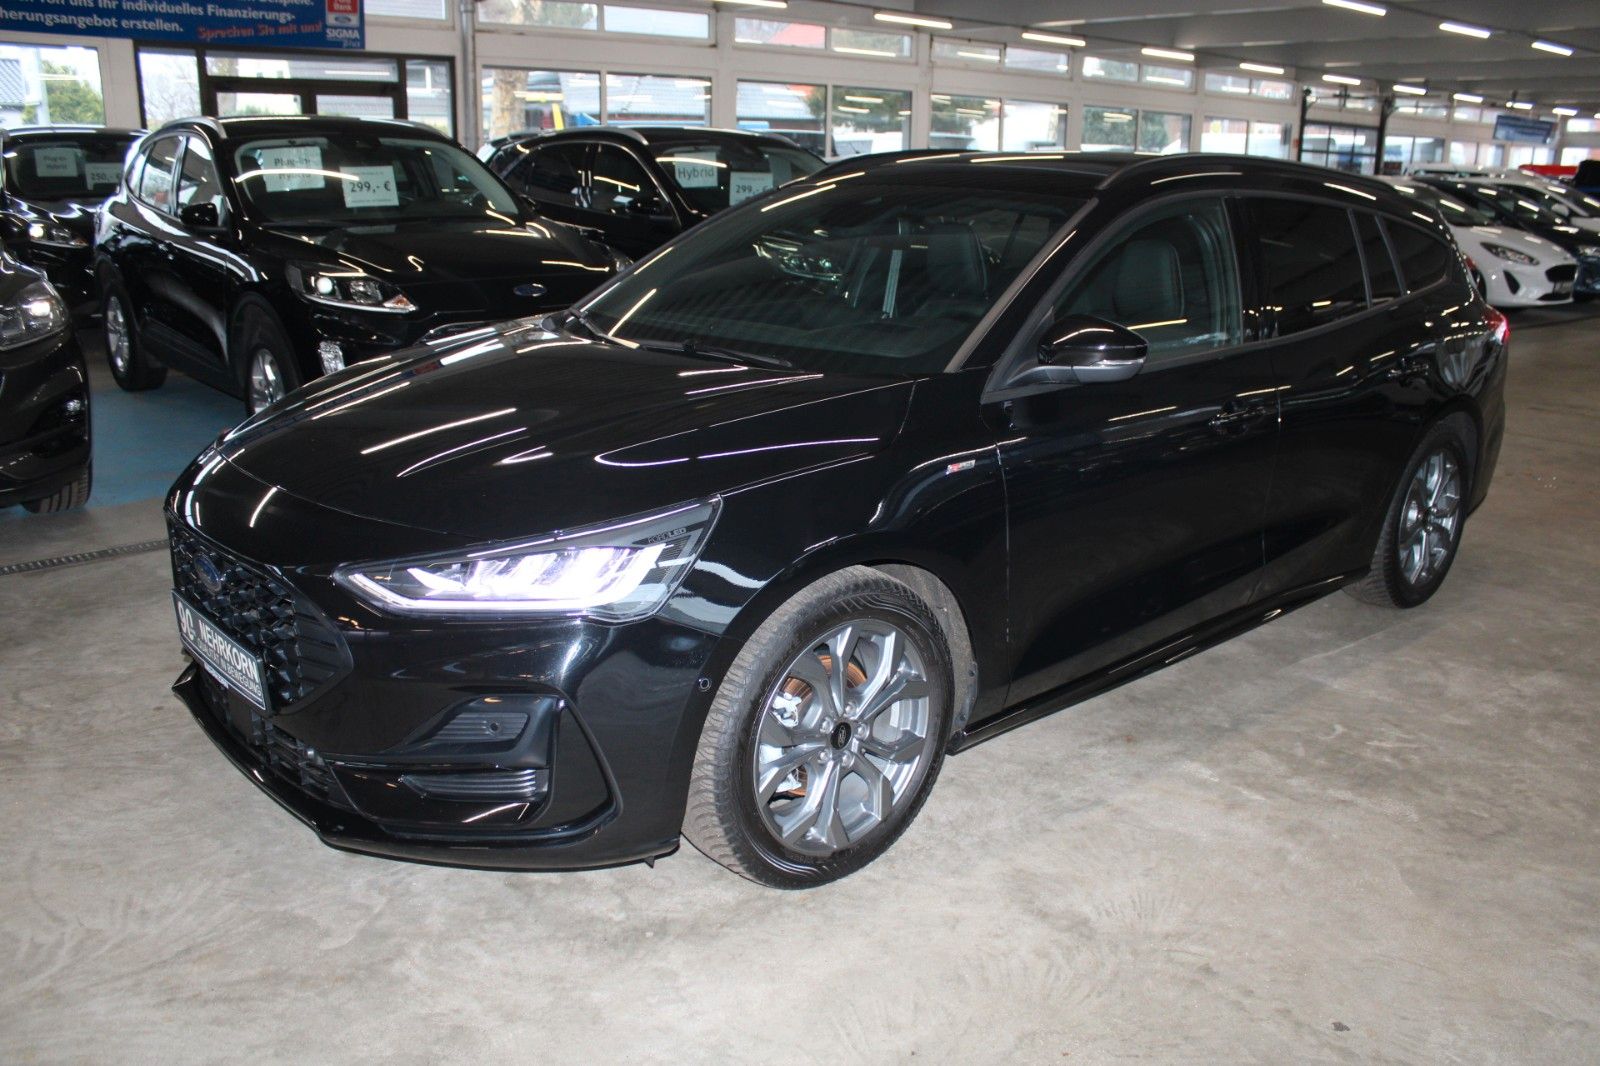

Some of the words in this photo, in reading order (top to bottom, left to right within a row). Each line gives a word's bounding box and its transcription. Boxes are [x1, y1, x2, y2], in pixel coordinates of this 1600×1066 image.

[122, 0, 204, 16] individuelles
[206, 4, 296, 23] Finanzierungs-
[121, 18, 184, 32] erstellen.
[326, 28, 360, 39] SIGMA
[677, 165, 715, 179] Hybrid
[350, 180, 381, 194] 299,-
[383, 180, 392, 192] €
[198, 619, 260, 684] NEHRKORN
